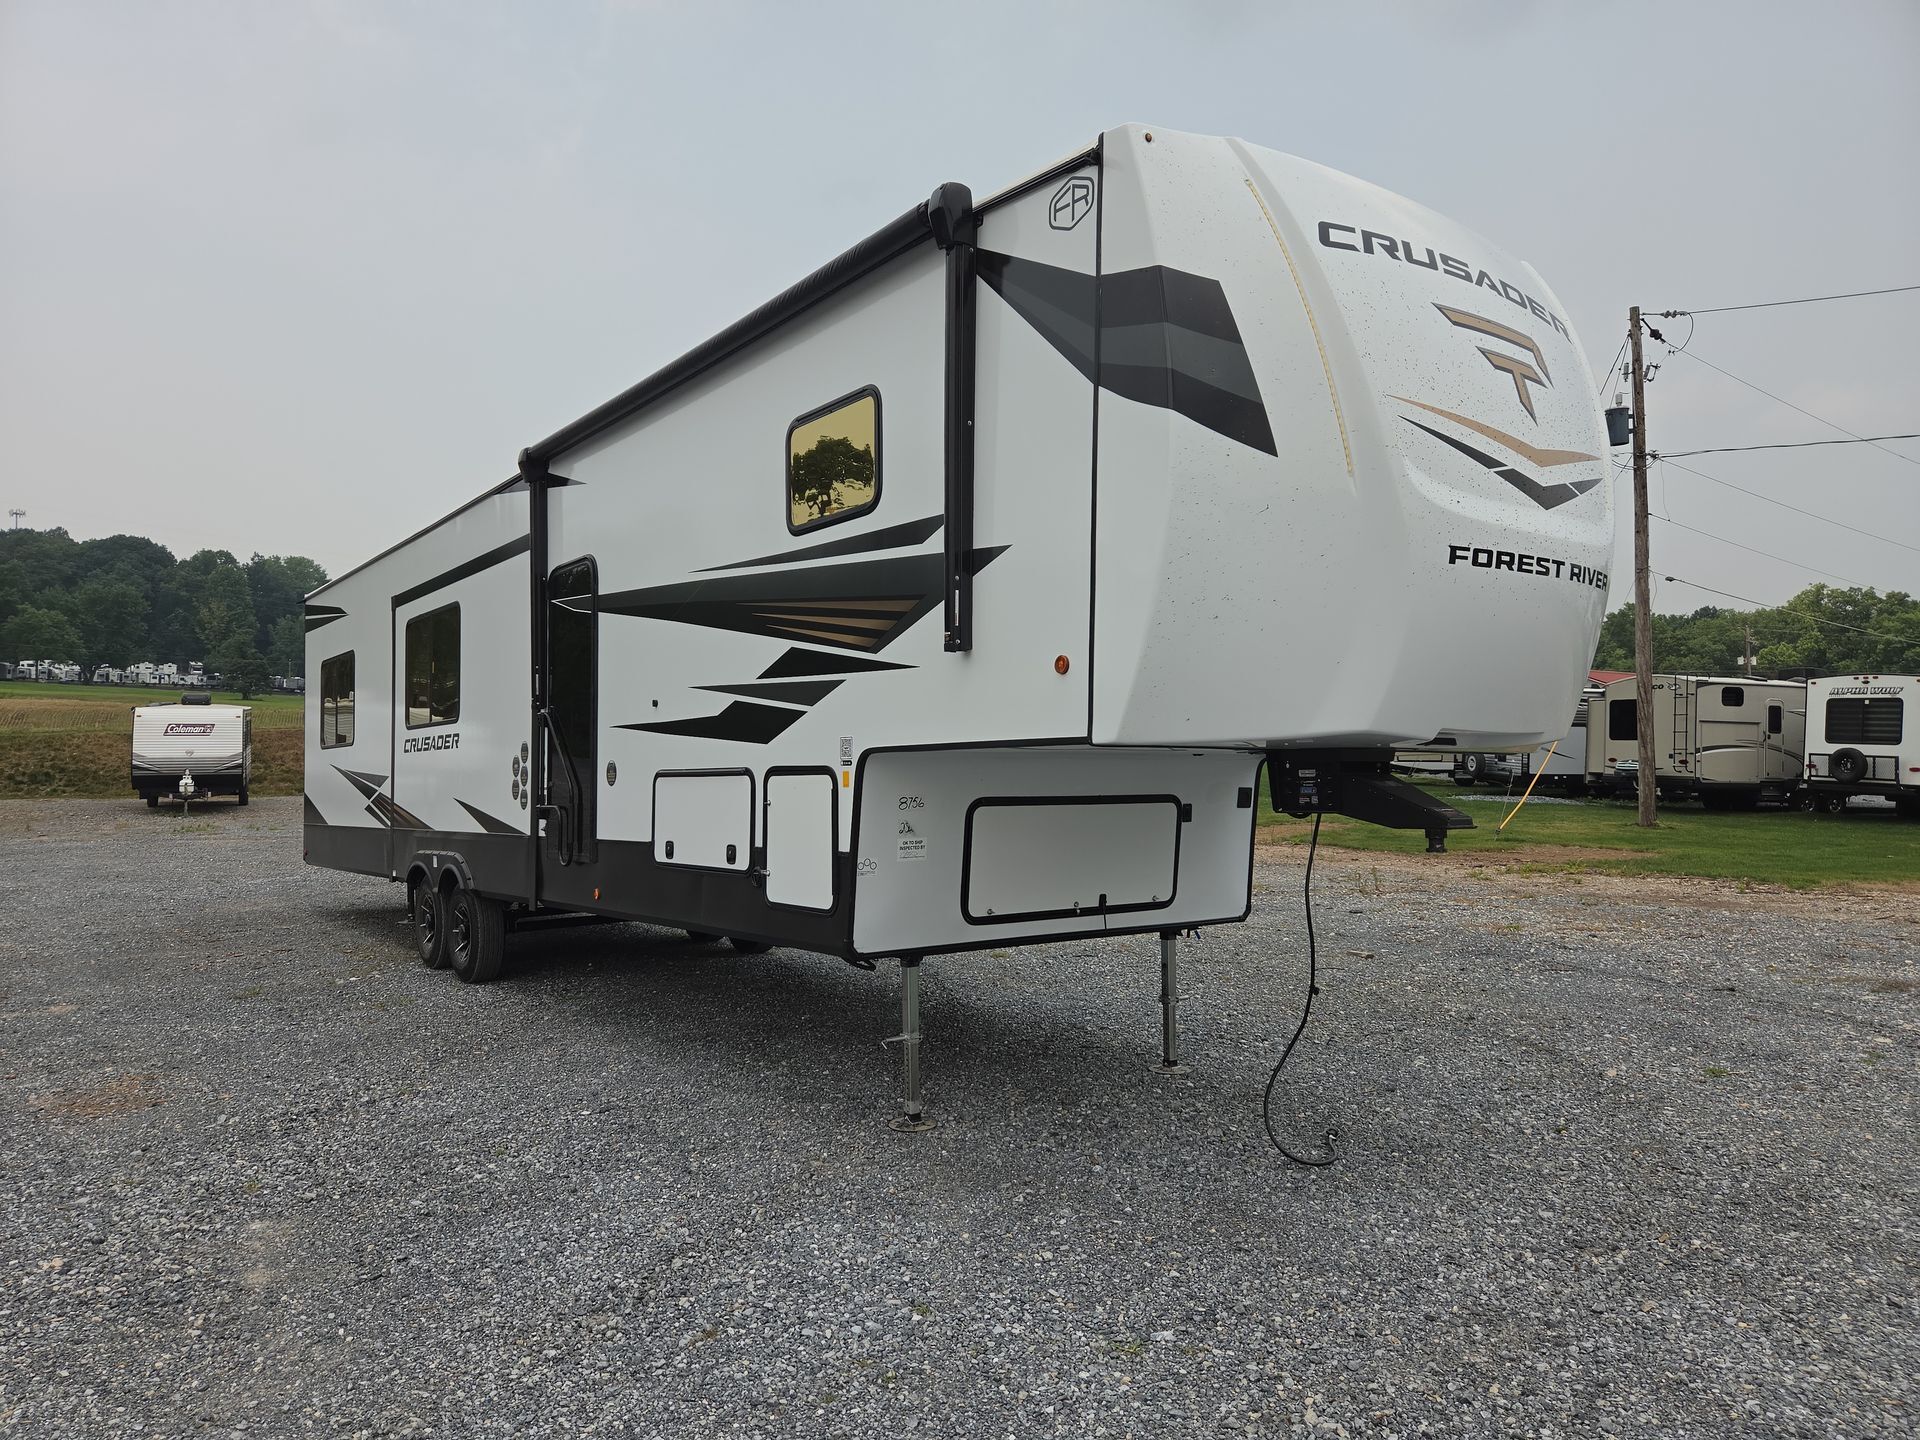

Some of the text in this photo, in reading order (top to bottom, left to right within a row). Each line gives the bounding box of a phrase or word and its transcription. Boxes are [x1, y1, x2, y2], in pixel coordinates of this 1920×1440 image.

[1318, 220, 1574, 345] CRUSADER
[1448, 544, 1609, 592] FOREST RIVER
[1829, 687, 1868, 695] ALPHA
[167, 724, 204, 733] Coleman
[404, 733, 460, 753] CRUSADER
[898, 796, 925, 811] 8756
